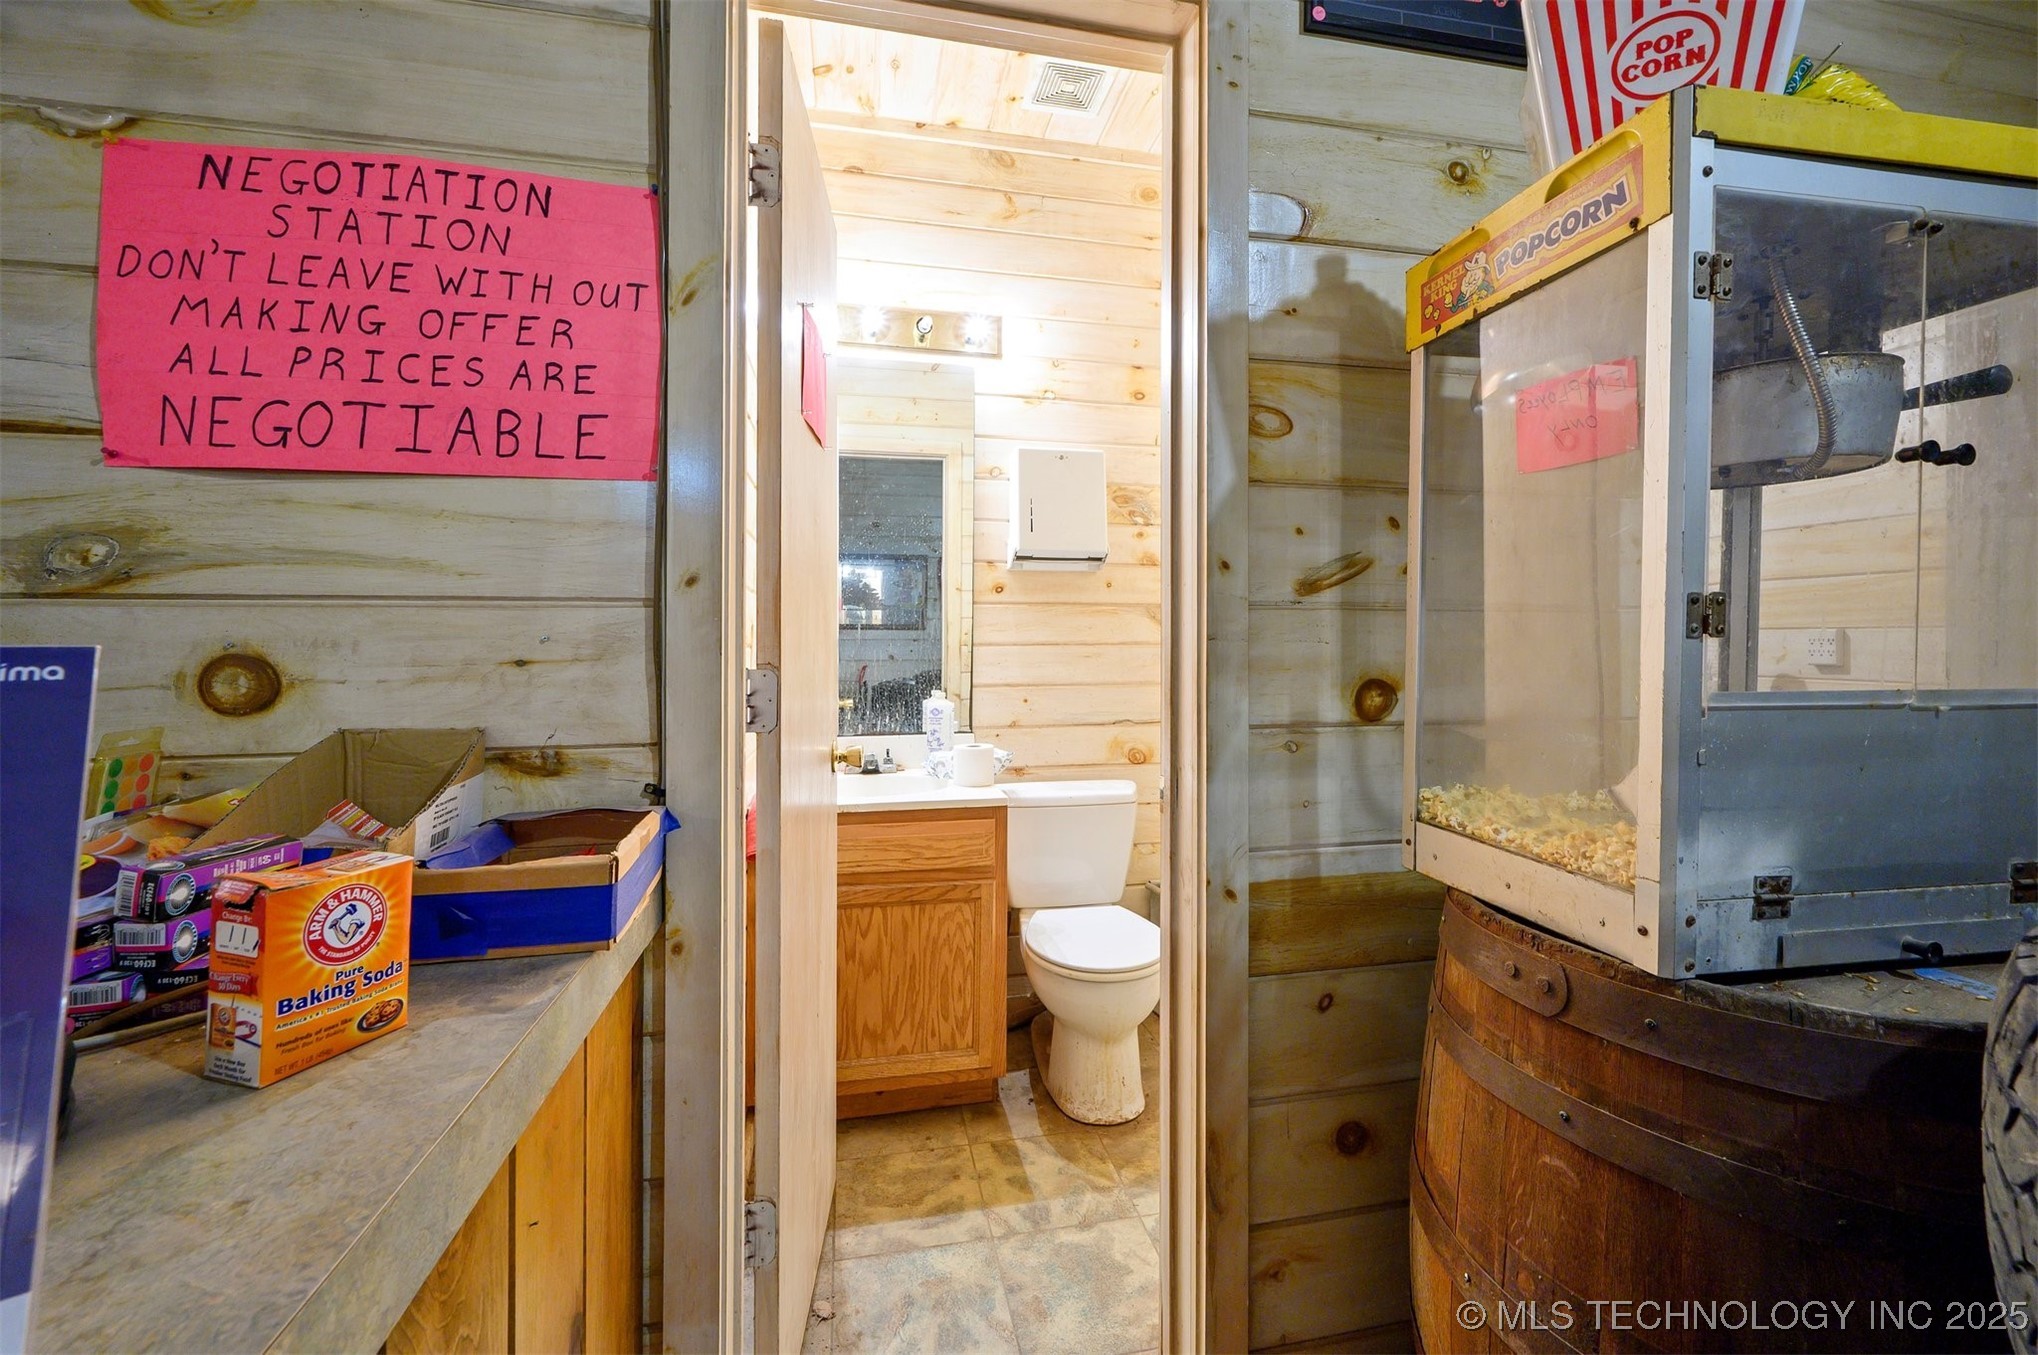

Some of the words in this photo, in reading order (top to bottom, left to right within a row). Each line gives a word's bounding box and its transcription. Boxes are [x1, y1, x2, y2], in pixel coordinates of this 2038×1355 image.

[1621, 44, 1706, 83] CORN
[1635, 28, 1694, 60] POP
[197, 153, 552, 218] NEGOTIATION
[266, 203, 511, 256] STATION
[1493, 177, 1630, 279] POPCORN
[116, 238, 247, 280] DON'T
[267, 251, 414, 295] LEAVE
[435, 263, 553, 305] WITH
[573, 280, 650, 313] OUT
[1423, 265, 1465, 296] KERNEL
[1431, 280, 1459, 303] KING
[170, 294, 388, 337] MAKING
[418, 308, 574, 350] OFFER
[169, 342, 263, 378] ALL
[288, 346, 485, 388] PRICES
[510, 359, 598, 396] ARE
[159, 394, 609, 461] NEGOTIABLE
[308, 909, 327, 941] ARM
[326, 898, 340, 910] &
[340, 887, 383, 923] HAMMER
[276, 979, 356, 1017] Baking
[362, 960, 403, 987] Soda
[335, 965, 364, 981] Pure
